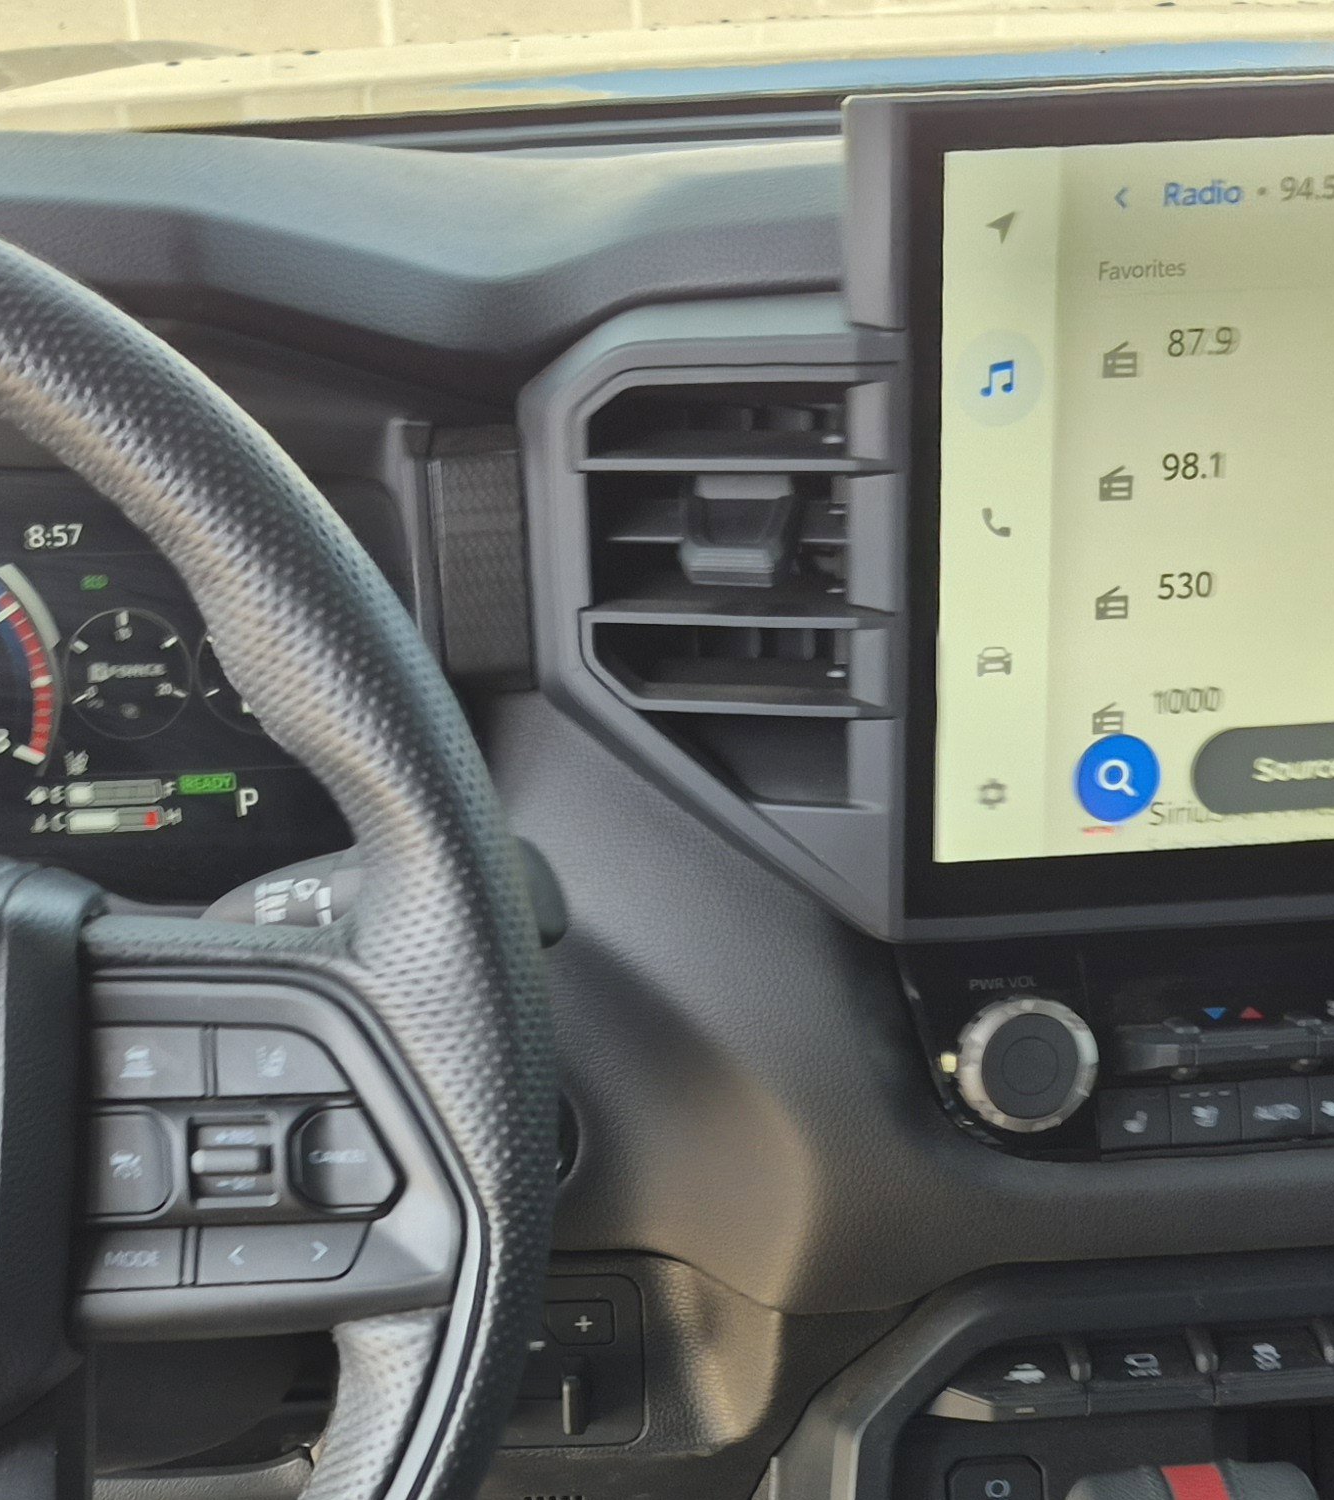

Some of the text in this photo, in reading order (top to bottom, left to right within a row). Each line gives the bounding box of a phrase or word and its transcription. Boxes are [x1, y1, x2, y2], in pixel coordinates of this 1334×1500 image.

[1163, 180, 1244, 207] Radio
[1098, 258, 1187, 282] Favorites
[1167, 326, 1241, 358] 87.9
[1162, 451, 1227, 482] 98.1
[23, 522, 84, 550] 8:57
[1157, 571, 1215, 601] 530
[1150, 685, 1225, 715] 1000
[236, 787, 259, 818] P
